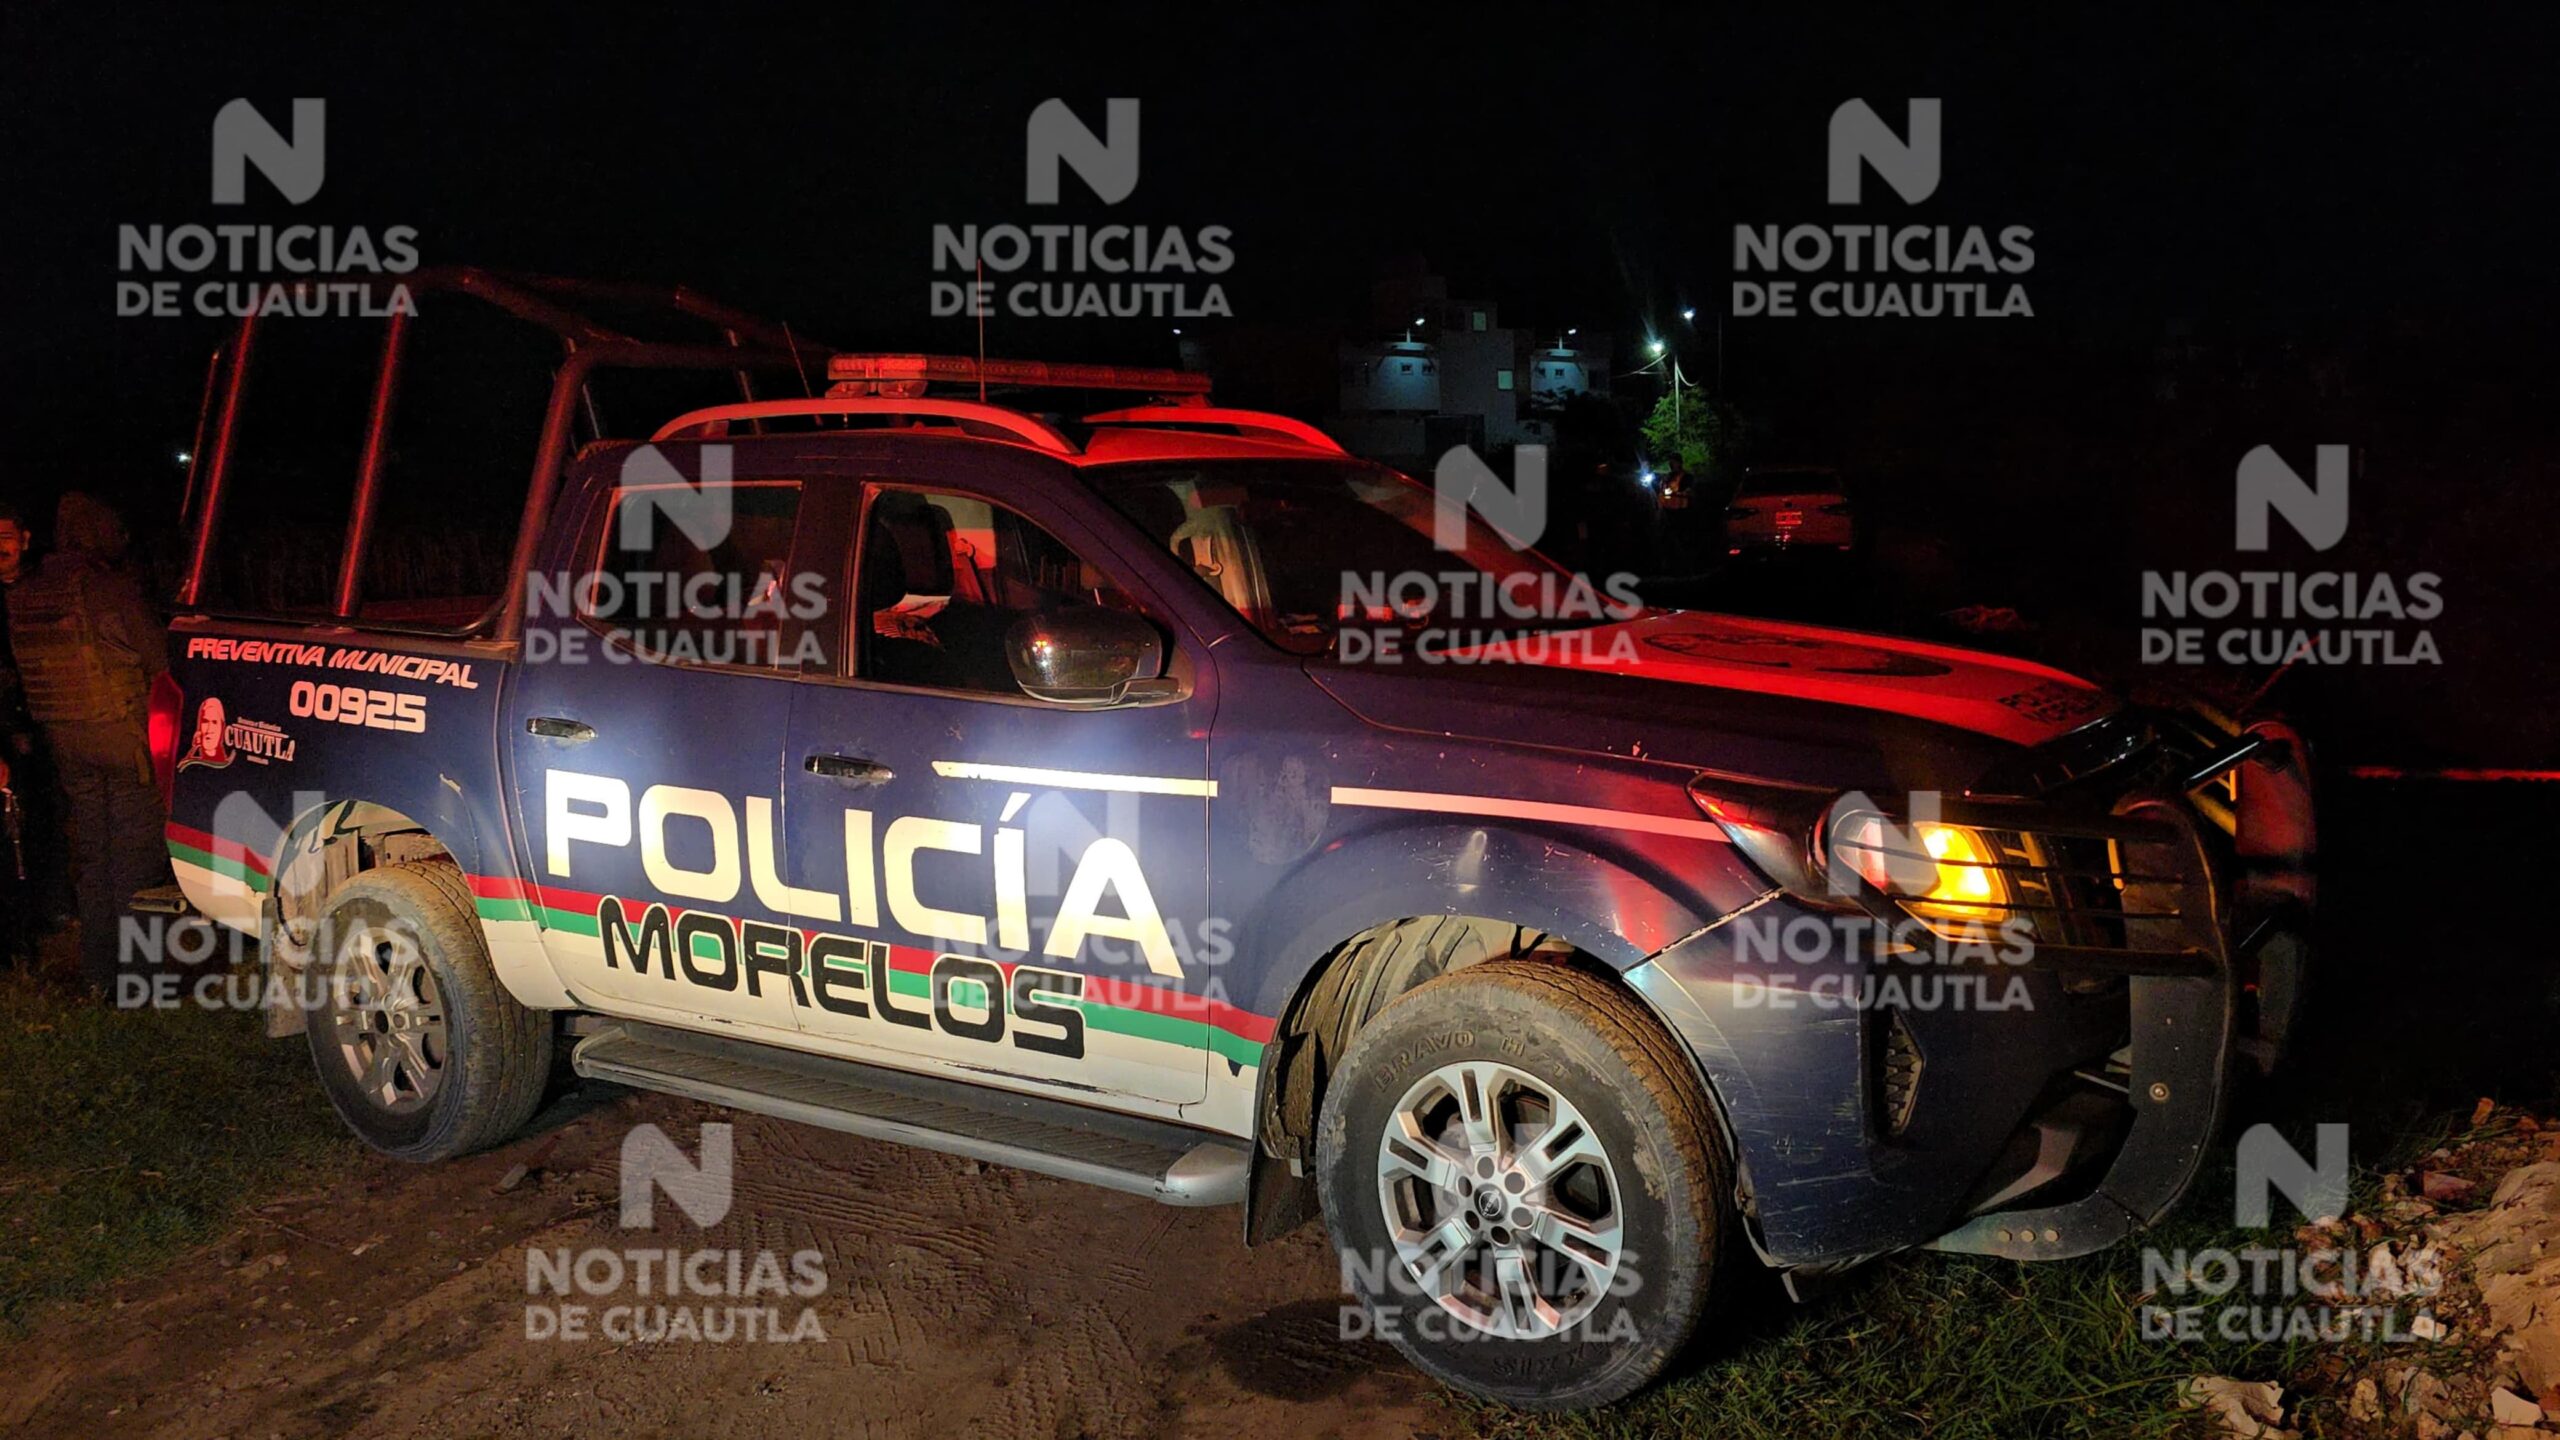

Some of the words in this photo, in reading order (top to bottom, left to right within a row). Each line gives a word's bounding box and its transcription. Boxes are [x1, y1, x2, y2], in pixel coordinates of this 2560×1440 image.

[187, 637, 323, 667] PREVENTIVA
[328, 648, 479, 690] MUNICIPAL
[289, 680, 427, 734] 00925
[224, 725, 296, 762] CUAUTLA
[545, 768, 1185, 979] POLICÍA
[599, 894, 1087, 1060] MORELOS
